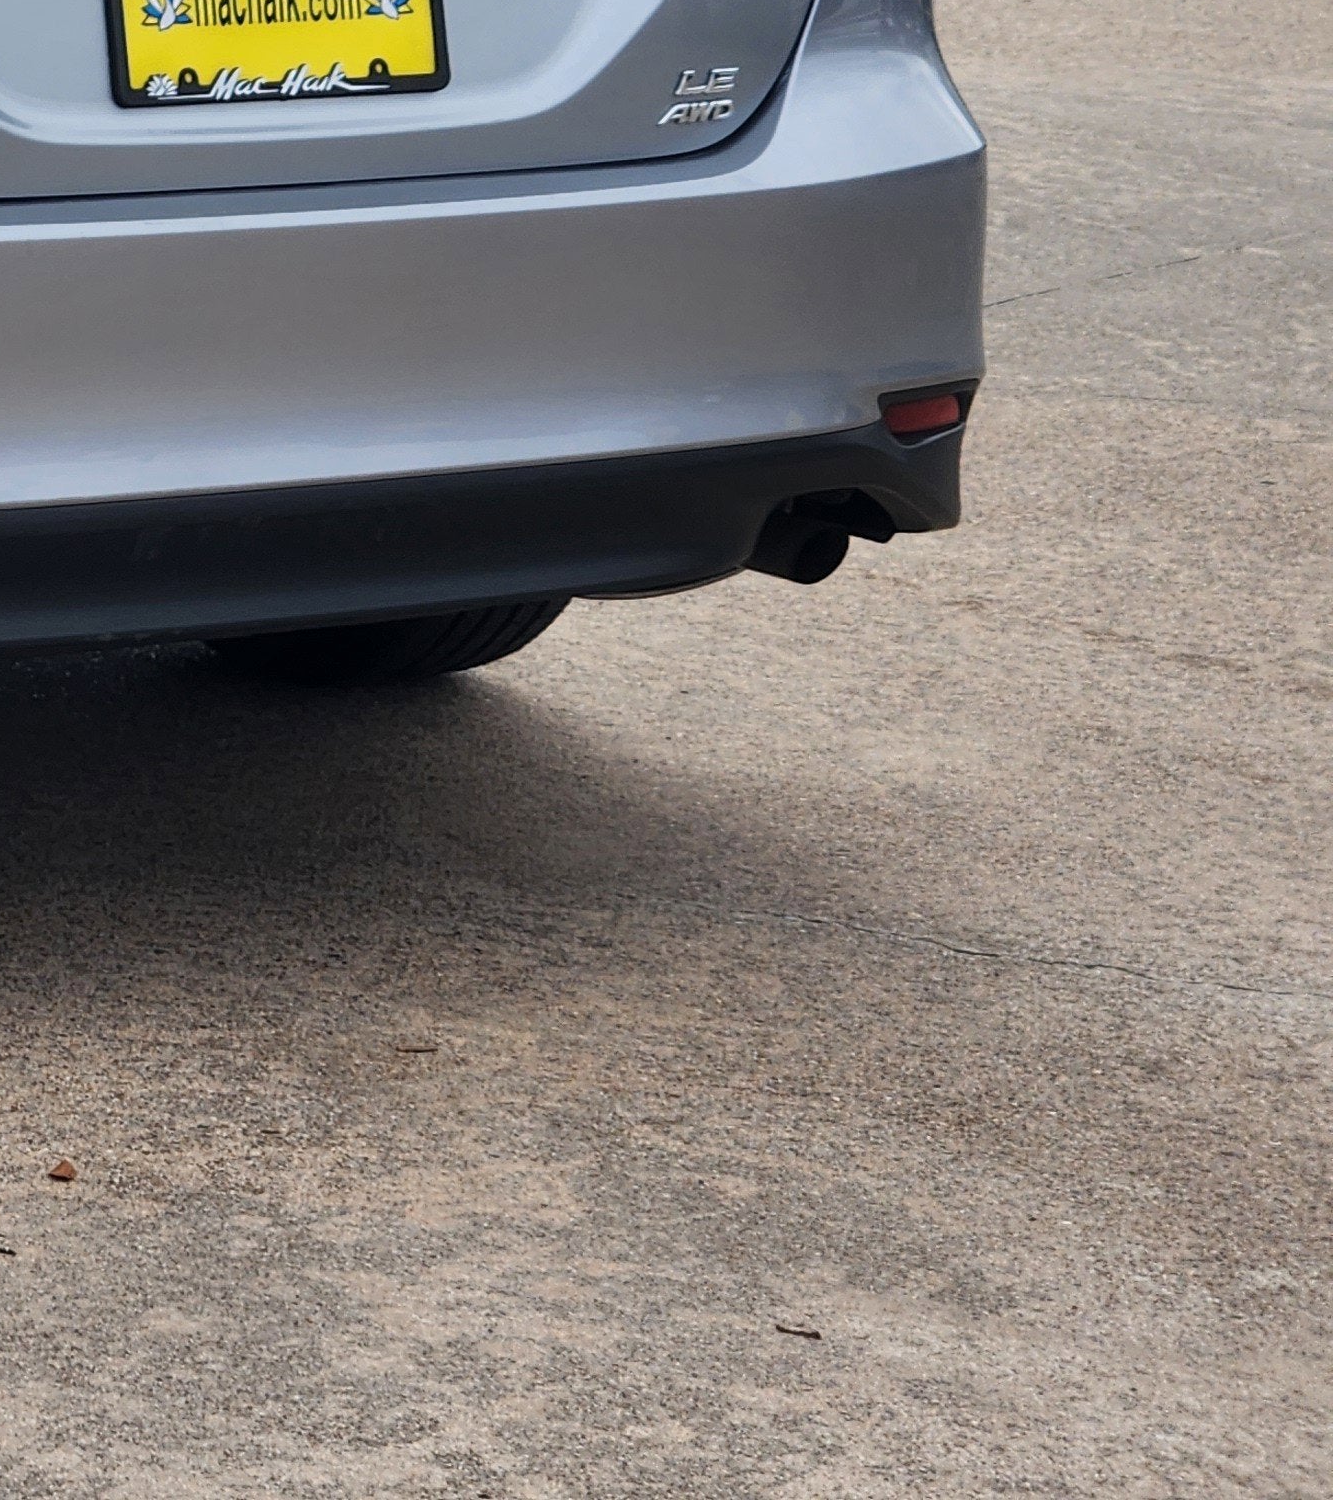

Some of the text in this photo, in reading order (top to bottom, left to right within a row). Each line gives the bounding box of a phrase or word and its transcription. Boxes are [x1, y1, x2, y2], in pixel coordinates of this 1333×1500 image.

[197, 62, 363, 102] Mac Haik
[674, 66, 740, 96] LE
[655, 98, 735, 127] AWD
